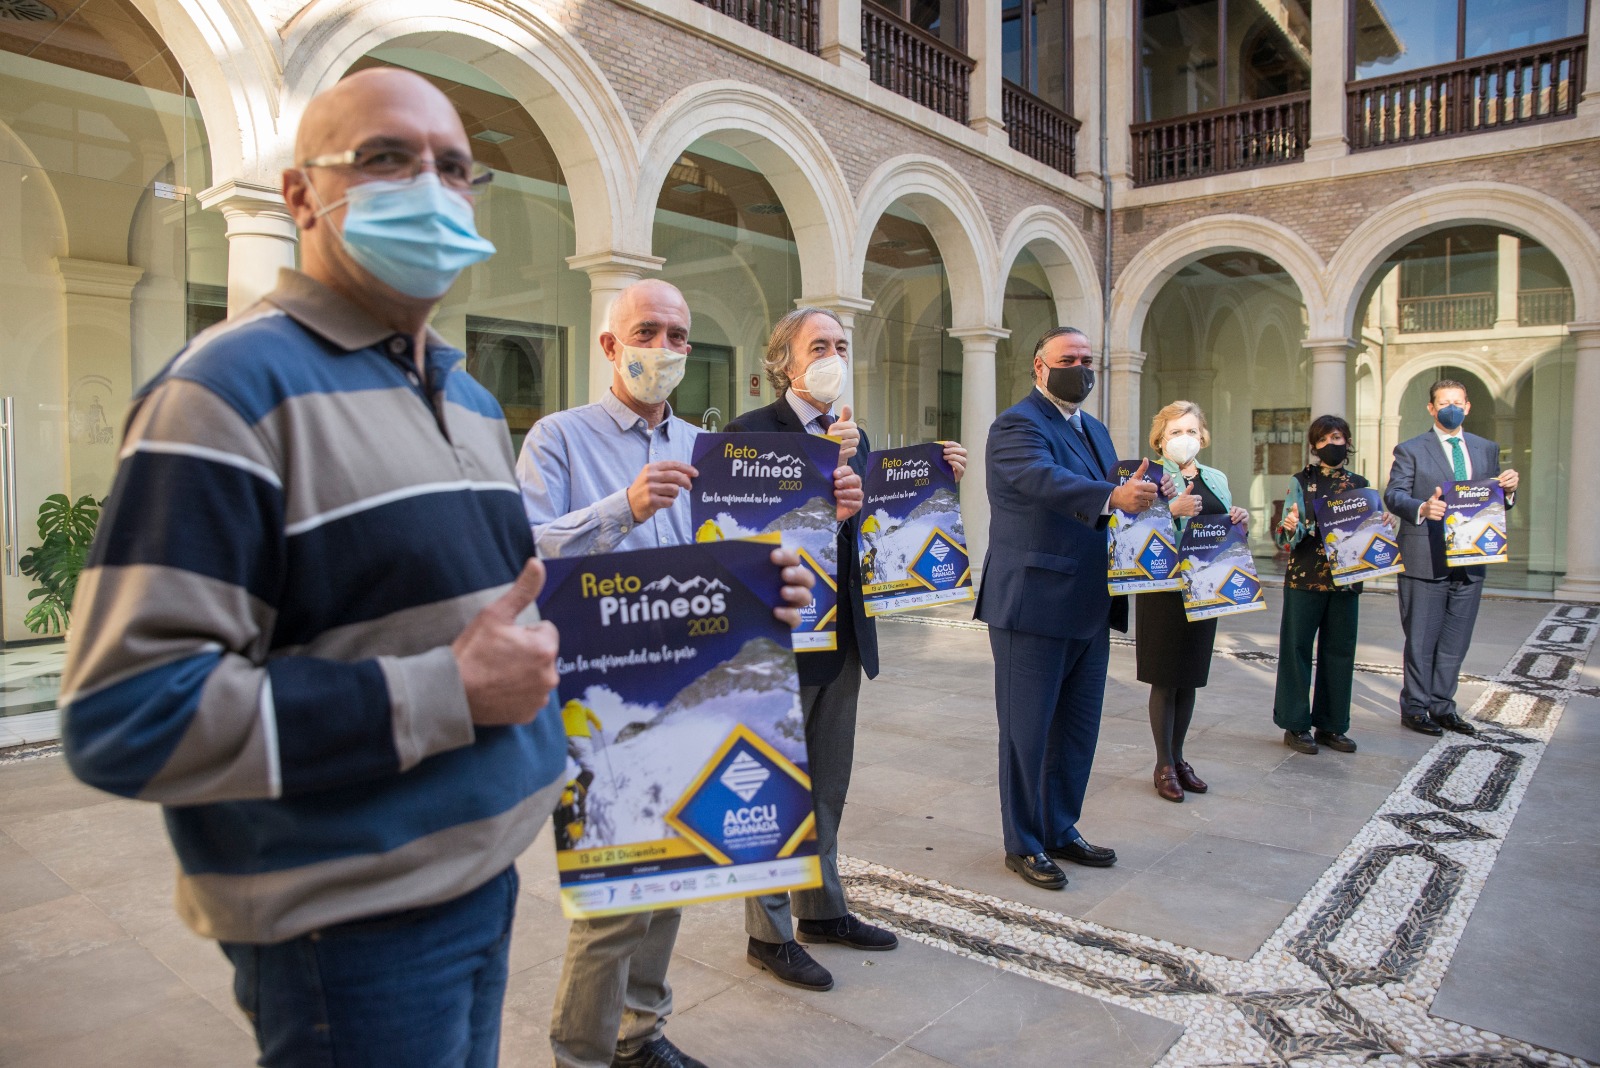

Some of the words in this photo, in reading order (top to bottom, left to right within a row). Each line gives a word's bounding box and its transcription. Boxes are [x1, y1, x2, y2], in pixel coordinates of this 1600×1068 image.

[724, 443, 758, 459] Reto
[731, 459, 802, 479] Pirineos
[882, 457, 902, 469] Reto
[886, 467, 929, 482] Pirineos
[914, 477, 930, 487] 2020
[778, 480, 803, 491] 2020
[721, 493, 754, 506] enfermedad
[1459, 490, 1489, 499] Pirineos
[1332, 500, 1367, 514] Pirineos
[1192, 527, 1226, 538] Pirineos
[931, 562, 954, 574] ACCU
[1150, 558, 1167, 566] ACCU
[581, 572, 641, 598] Reto
[600, 592, 726, 627] Pirineos
[687, 616, 729, 637] 2020
[590, 647, 648, 675] enfermedad
[723, 803, 777, 827] ACCU
[723, 820, 780, 838] GRANADA
[580, 853, 590, 864] 13
[604, 850, 615, 861] 21
[617, 846, 668, 860] Diciembre
